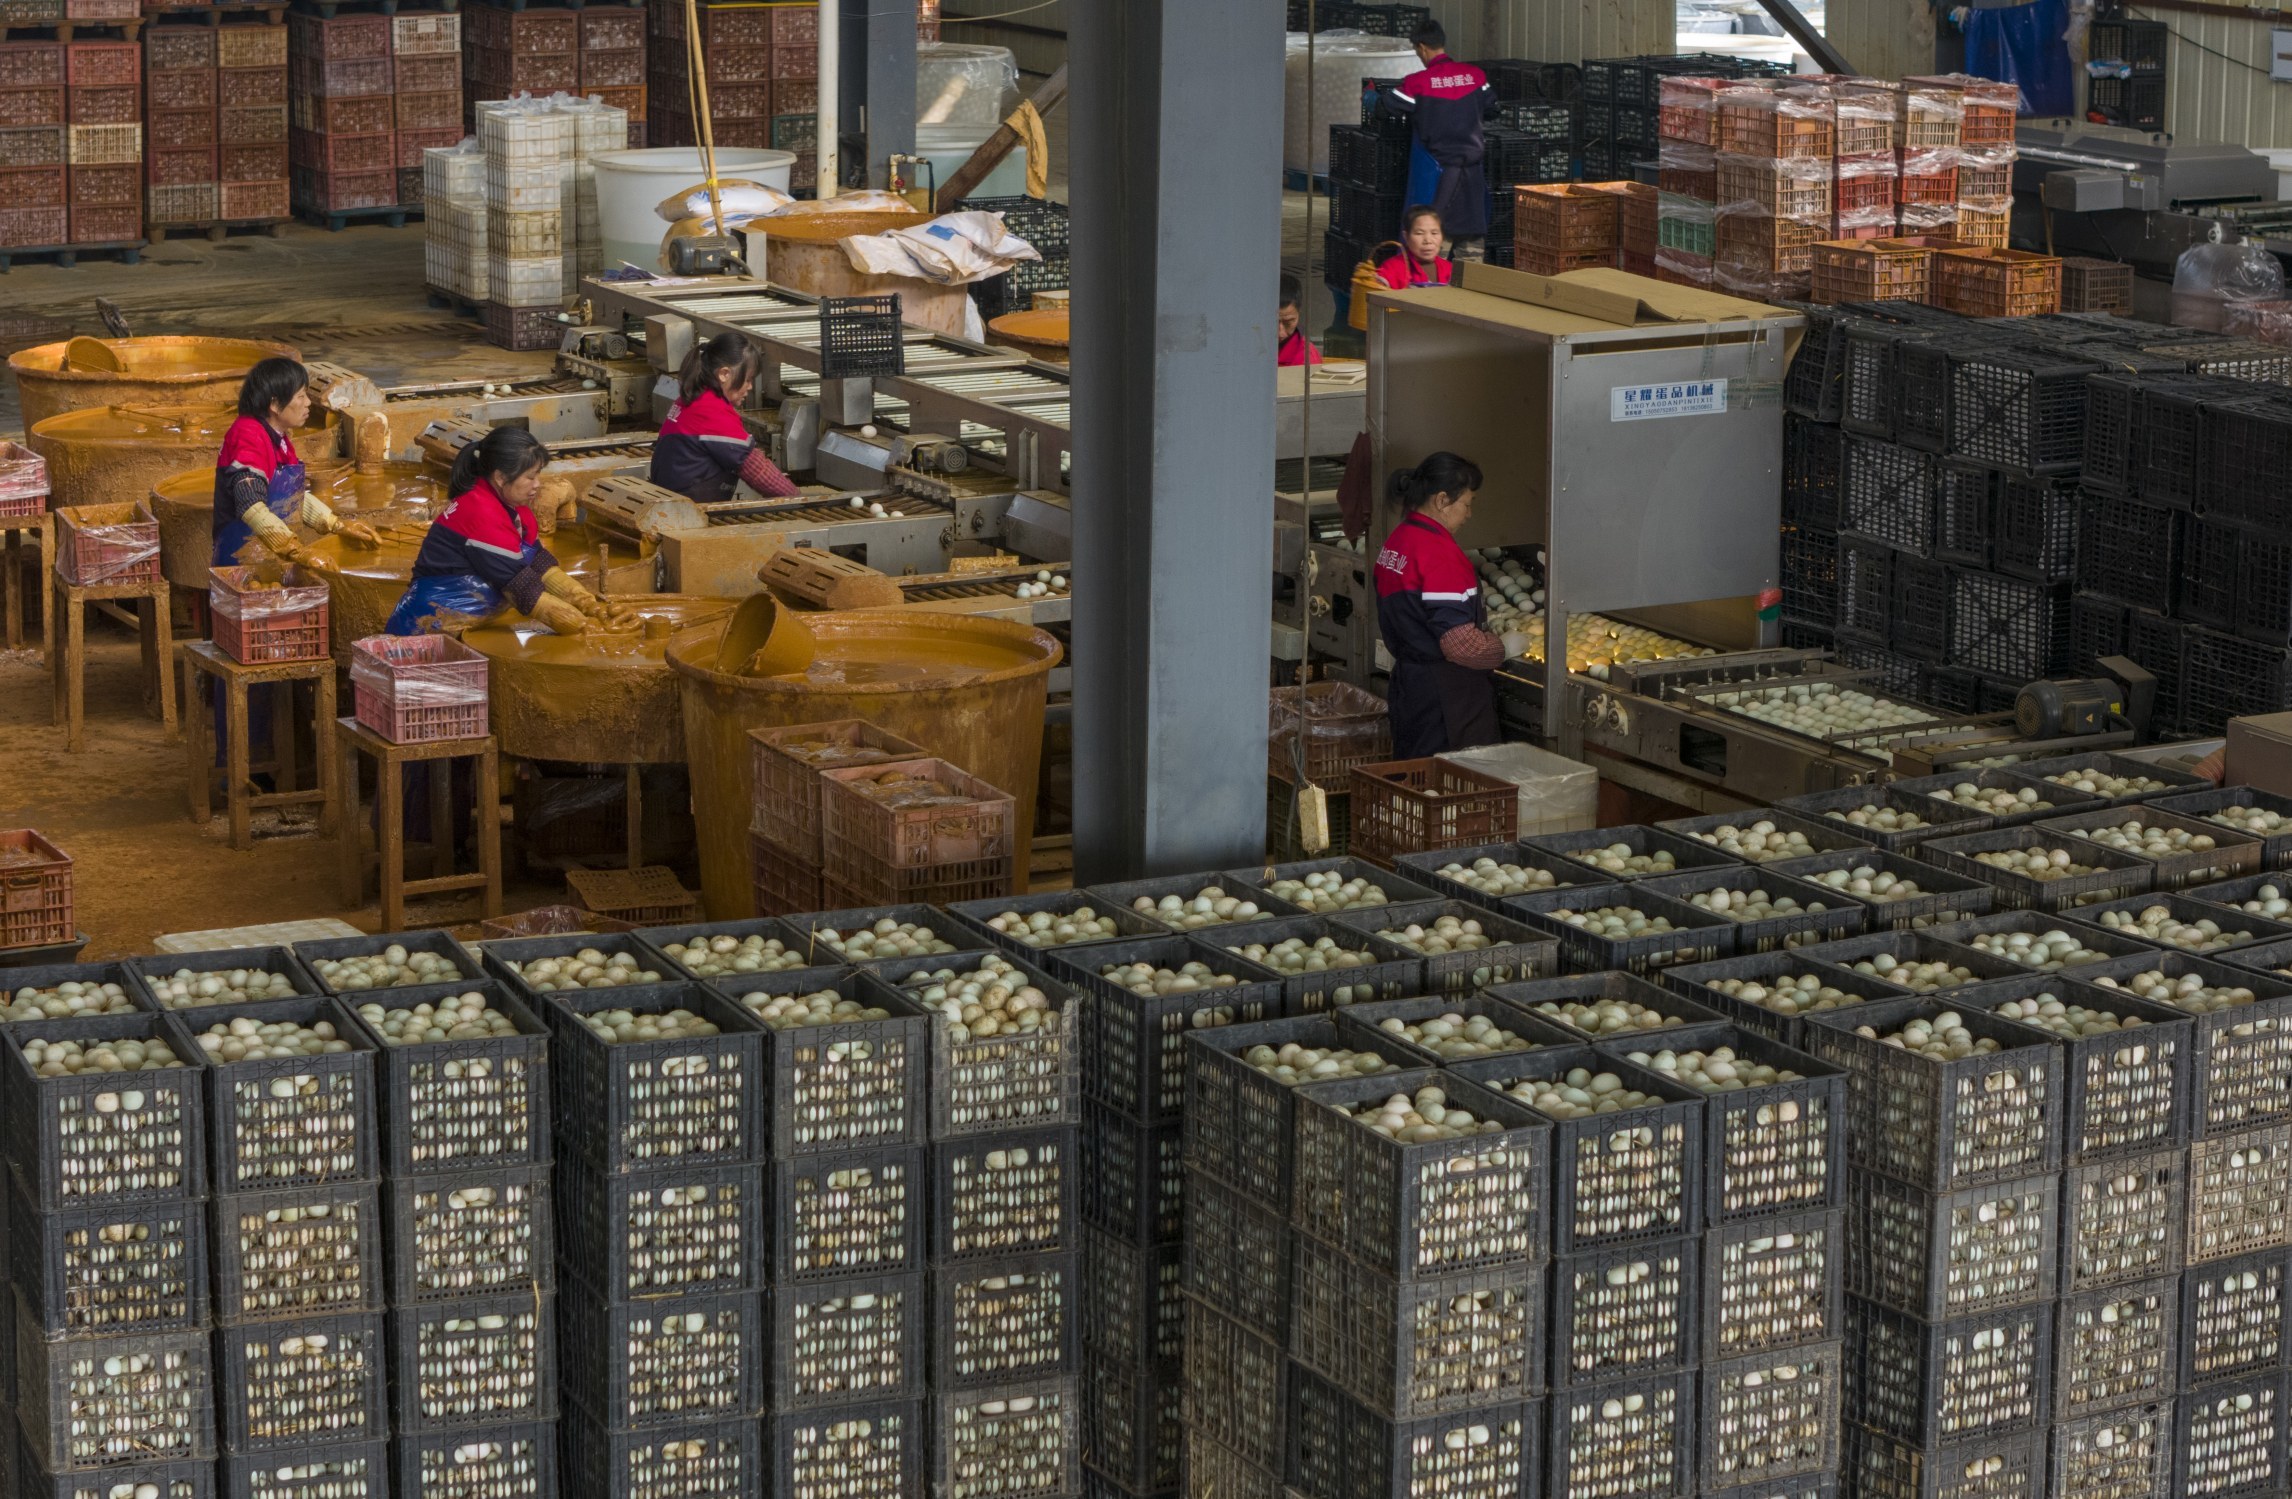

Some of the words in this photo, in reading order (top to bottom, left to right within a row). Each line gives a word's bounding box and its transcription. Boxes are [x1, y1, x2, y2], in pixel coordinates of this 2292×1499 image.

[1624, 383, 1714, 403] 星耀蛋品机械
